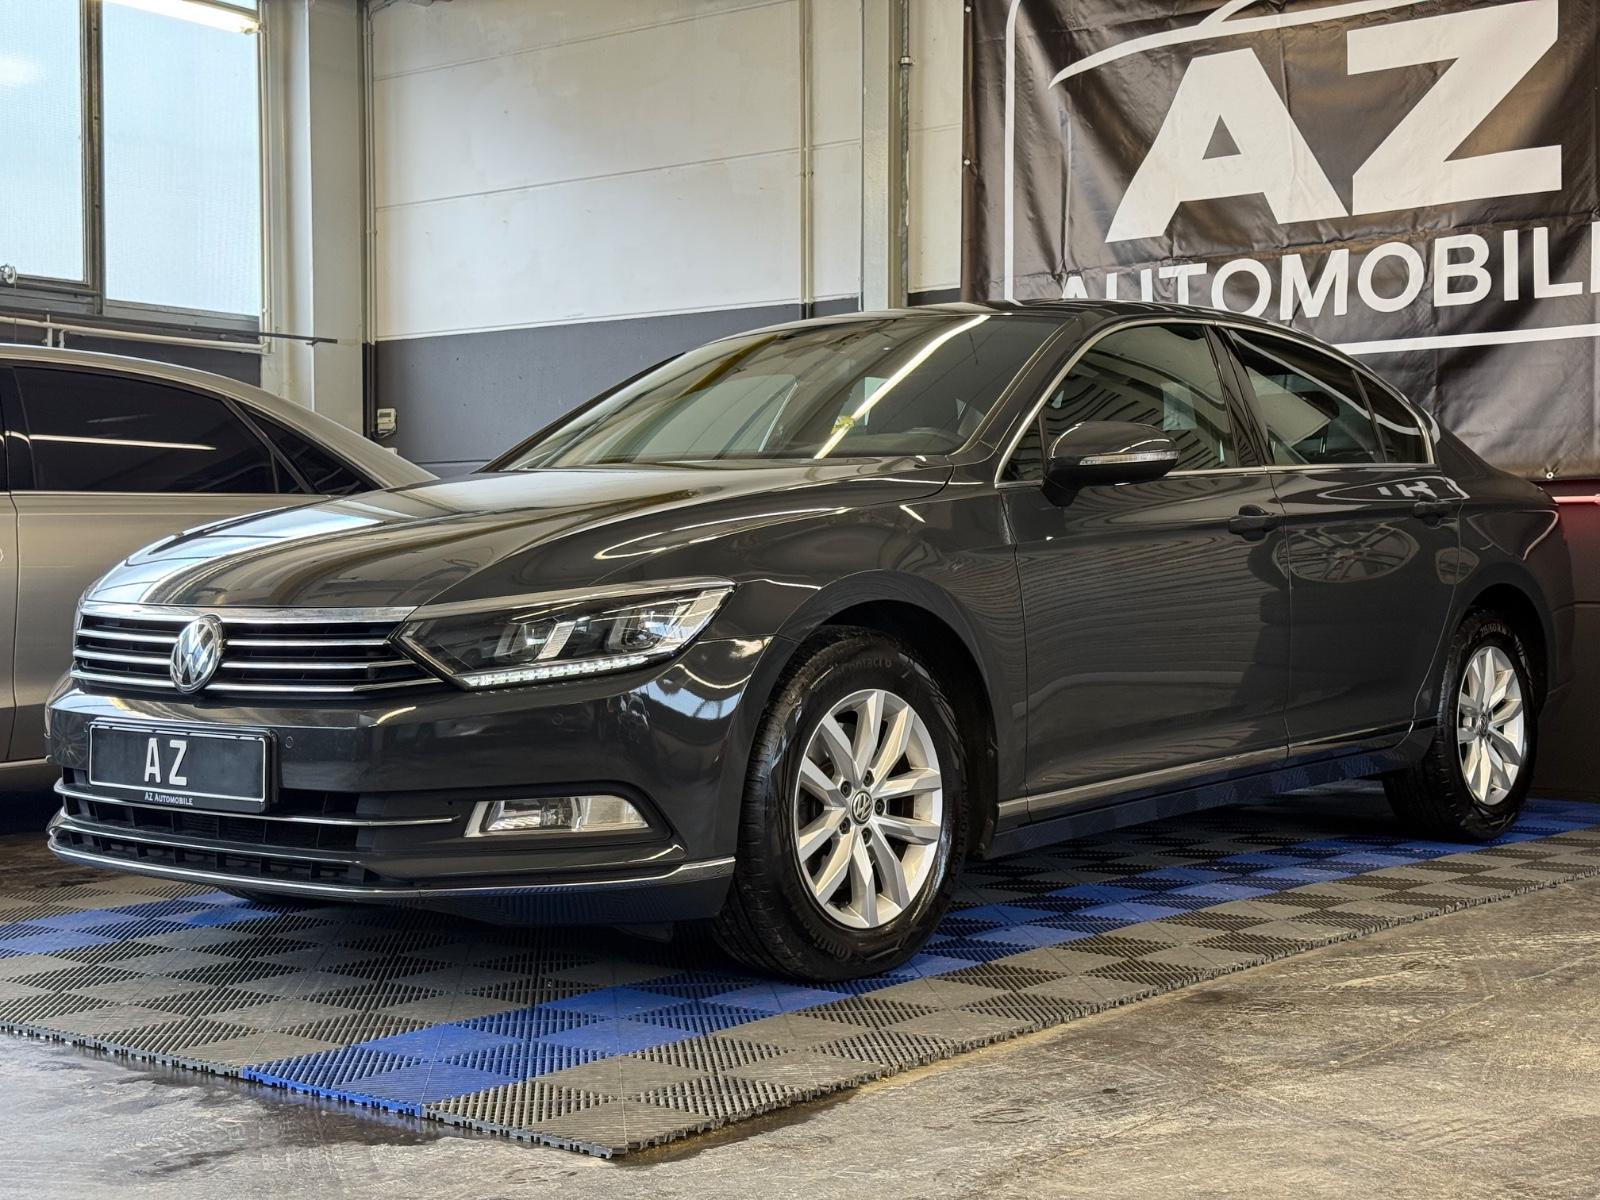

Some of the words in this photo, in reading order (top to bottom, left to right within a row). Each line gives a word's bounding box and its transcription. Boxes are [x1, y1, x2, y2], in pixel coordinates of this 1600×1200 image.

[1105, 0, 1562, 243] AZ
[1061, 221, 1600, 320] TOMOBIL
[144, 737, 188, 786] AZ
